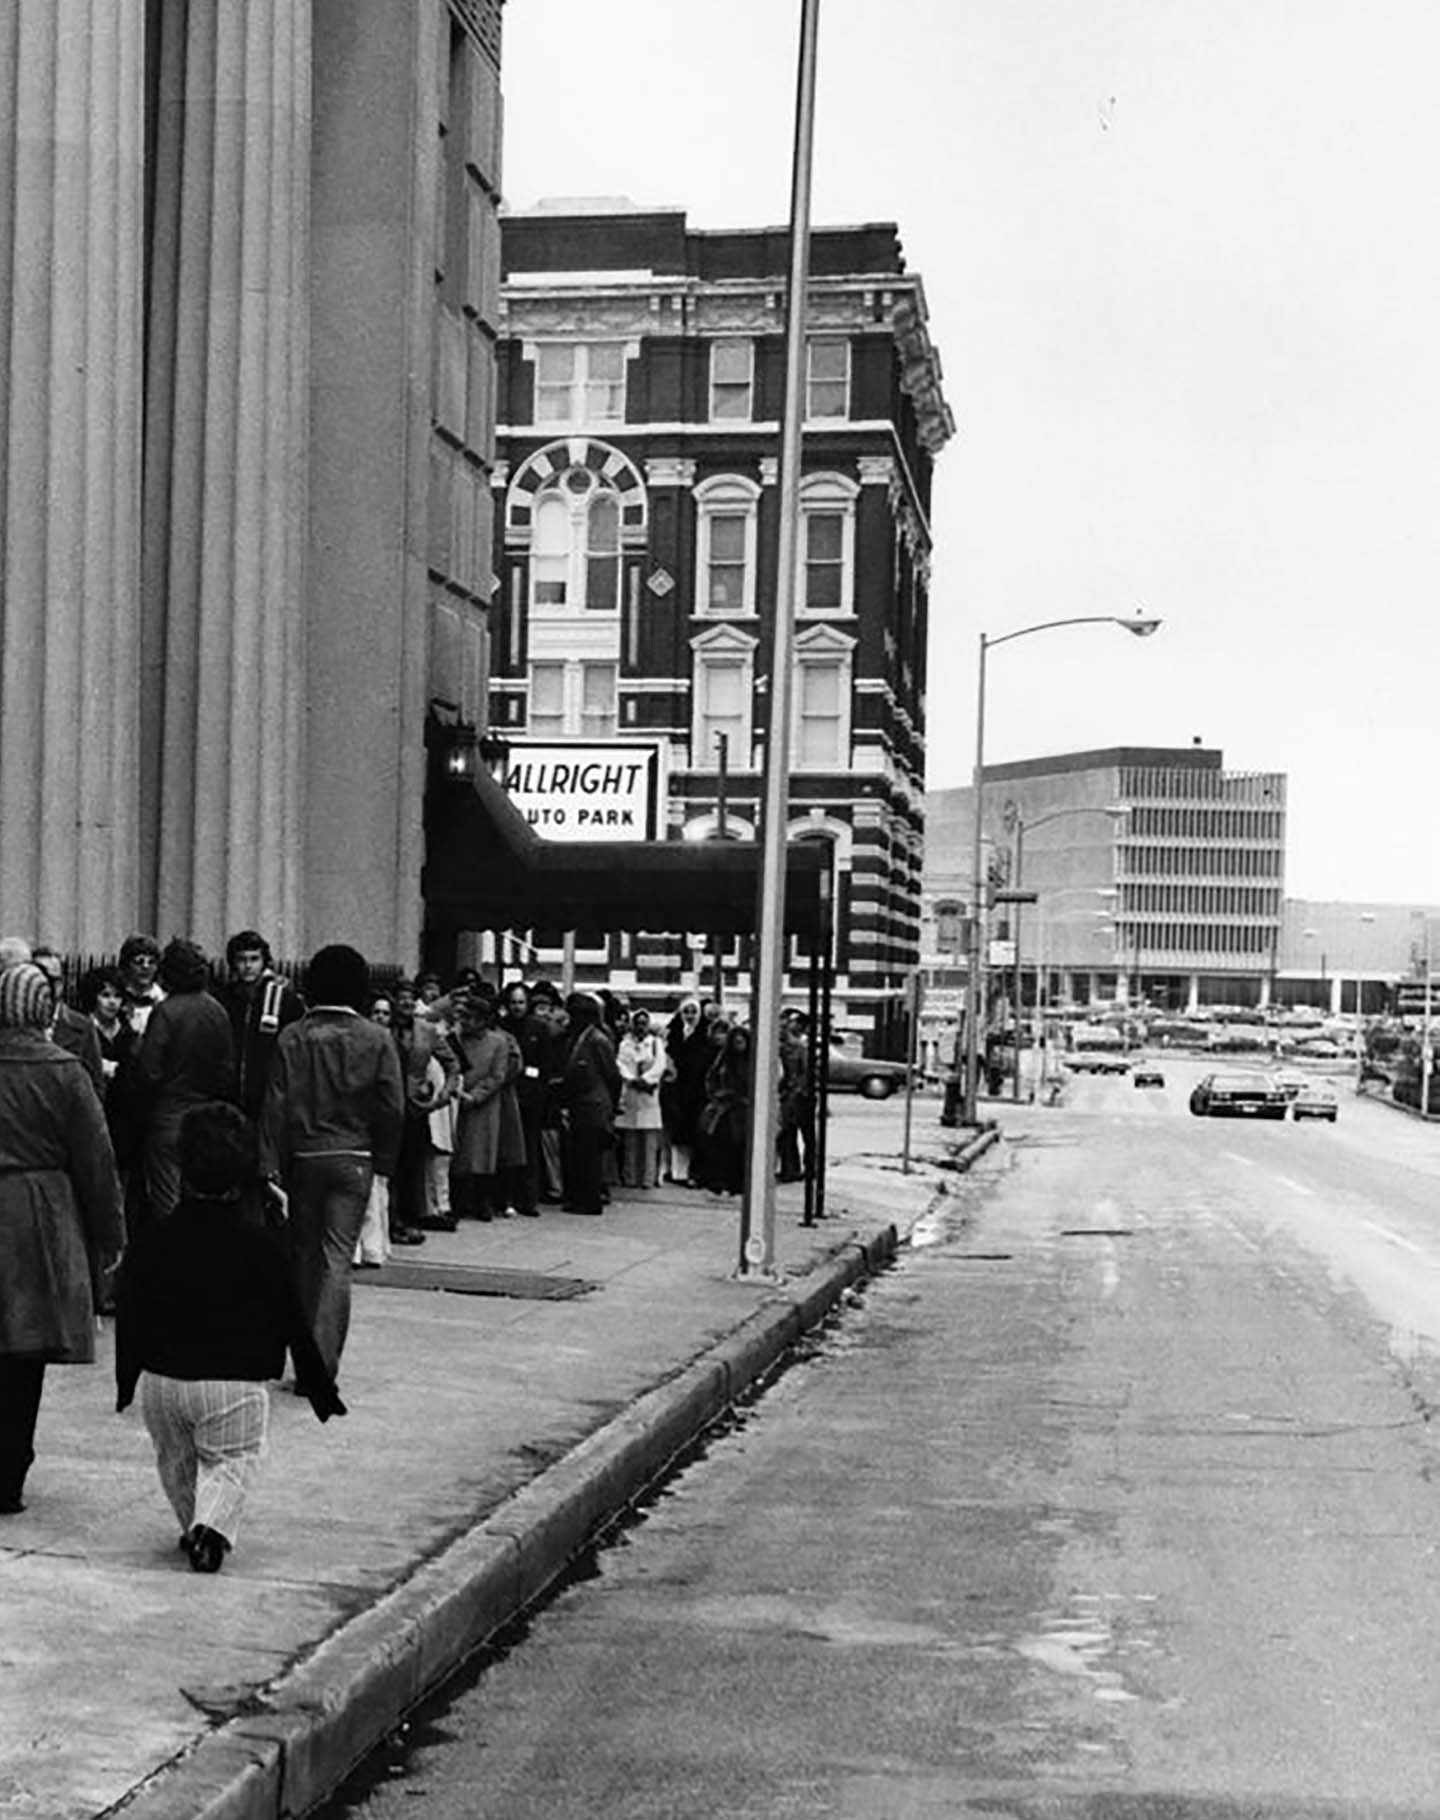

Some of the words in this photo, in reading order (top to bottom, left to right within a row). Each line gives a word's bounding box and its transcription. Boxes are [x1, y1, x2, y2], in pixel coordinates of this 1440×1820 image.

[502, 763, 643, 794] ALLRIGHT
[526, 808, 566, 825] UTO
[578, 809, 634, 825] PARK
